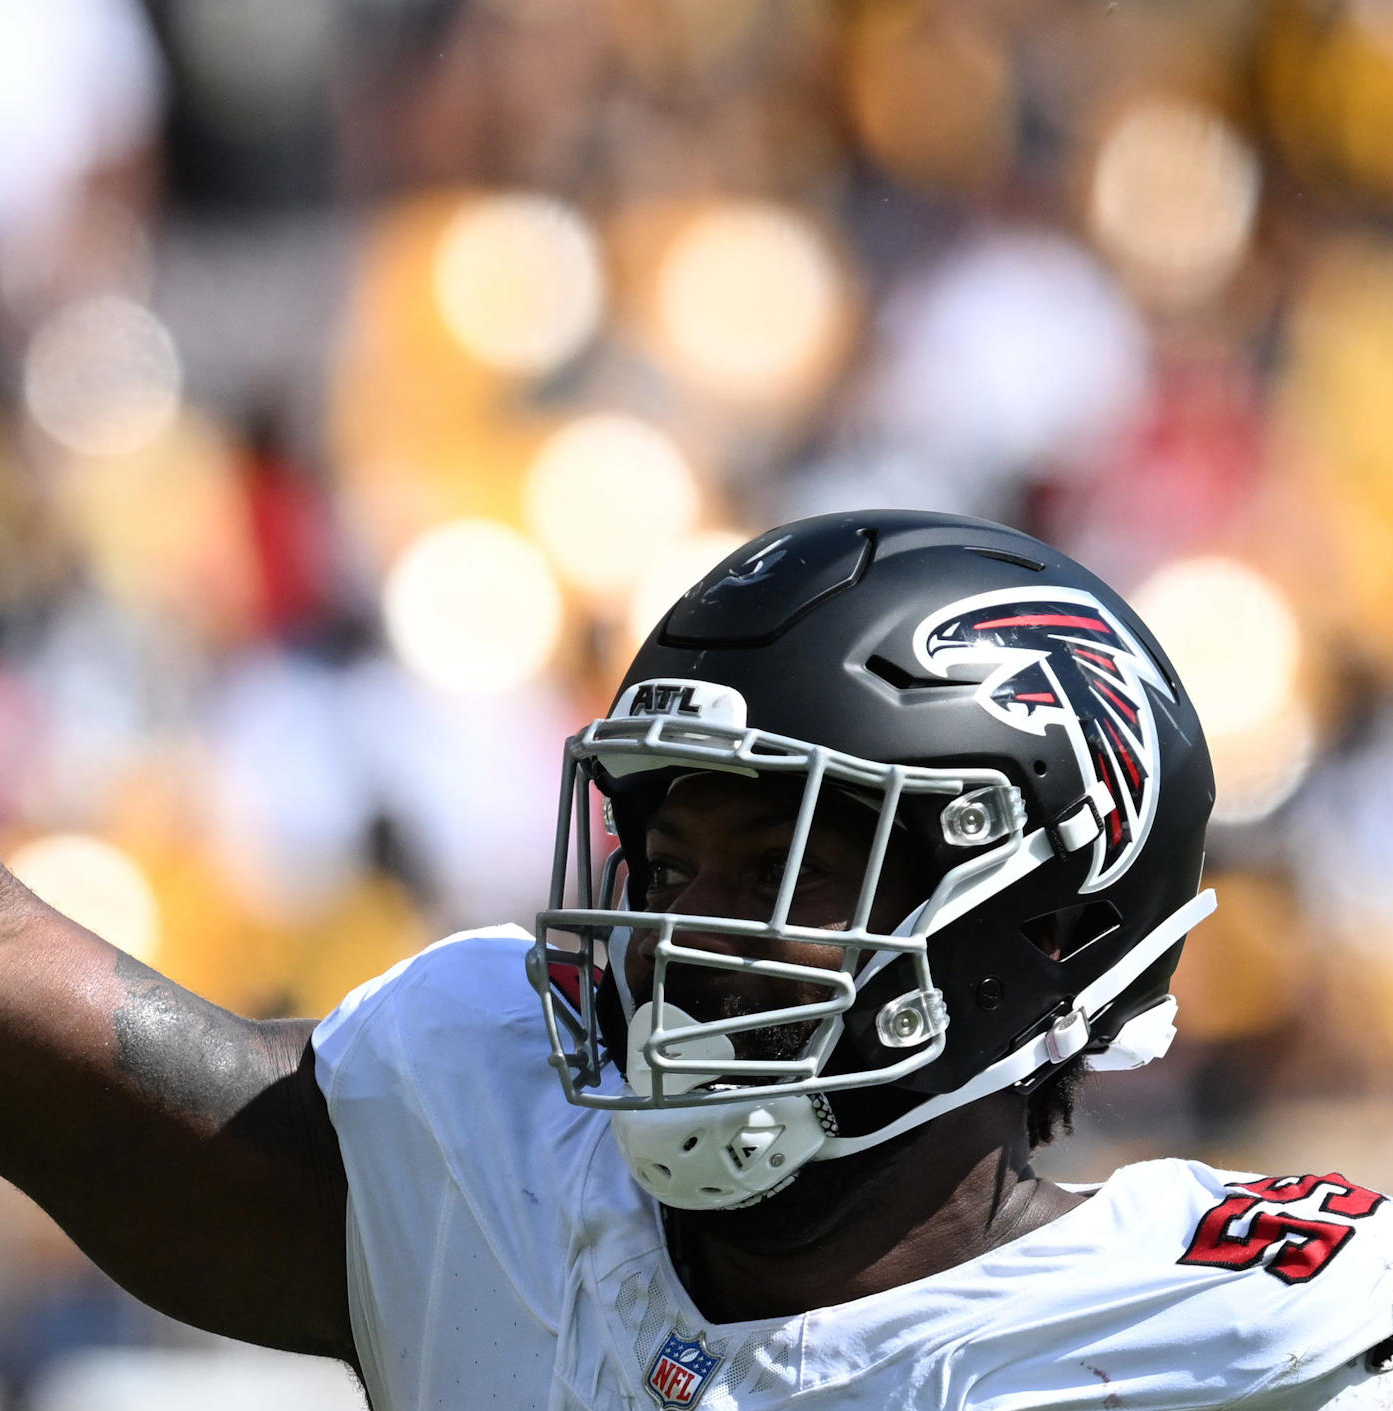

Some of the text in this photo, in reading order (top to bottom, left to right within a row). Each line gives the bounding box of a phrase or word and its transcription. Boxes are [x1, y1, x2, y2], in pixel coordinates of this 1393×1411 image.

[629, 686, 701, 716] ATL
[1175, 1172, 1390, 1285] 55
[652, 1357, 695, 1402] NFL
